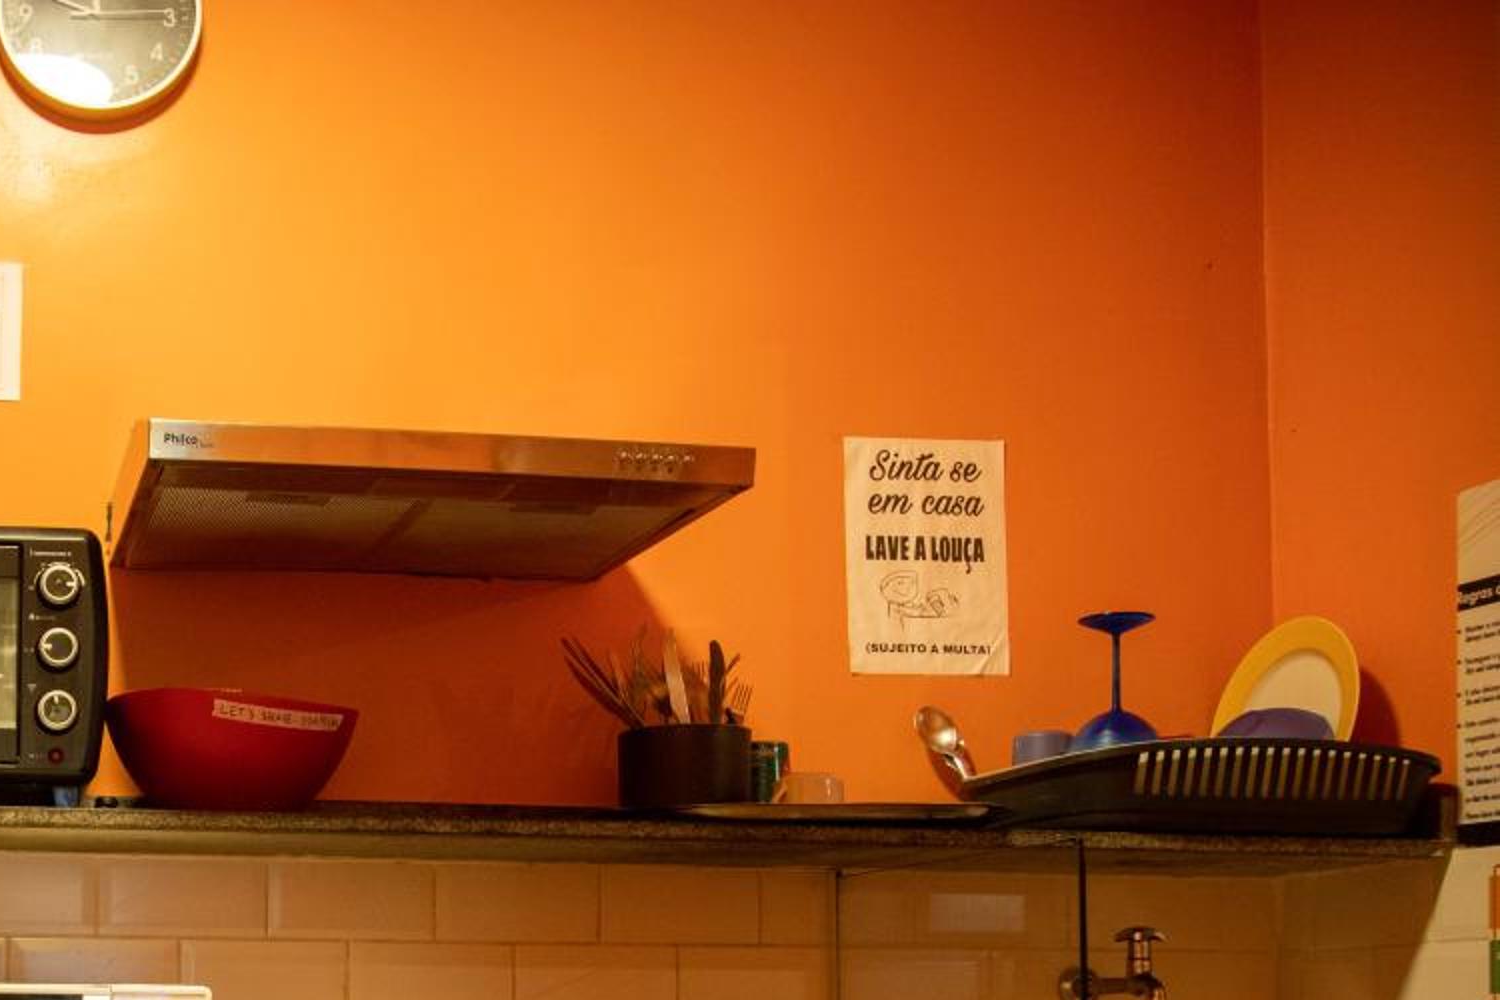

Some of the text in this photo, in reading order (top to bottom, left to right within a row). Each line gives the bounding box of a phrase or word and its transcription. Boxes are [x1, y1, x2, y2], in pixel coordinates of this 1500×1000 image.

[162, 7, 177, 28] 3
[149, 43, 164, 61] 4
[869, 449, 982, 483] Sinta se
[867, 492, 985, 517] em casa
[865, 535, 985, 574] LAVE A LOUÇA
[865, 642, 992, 656] (SUJEITO A MULTA)
